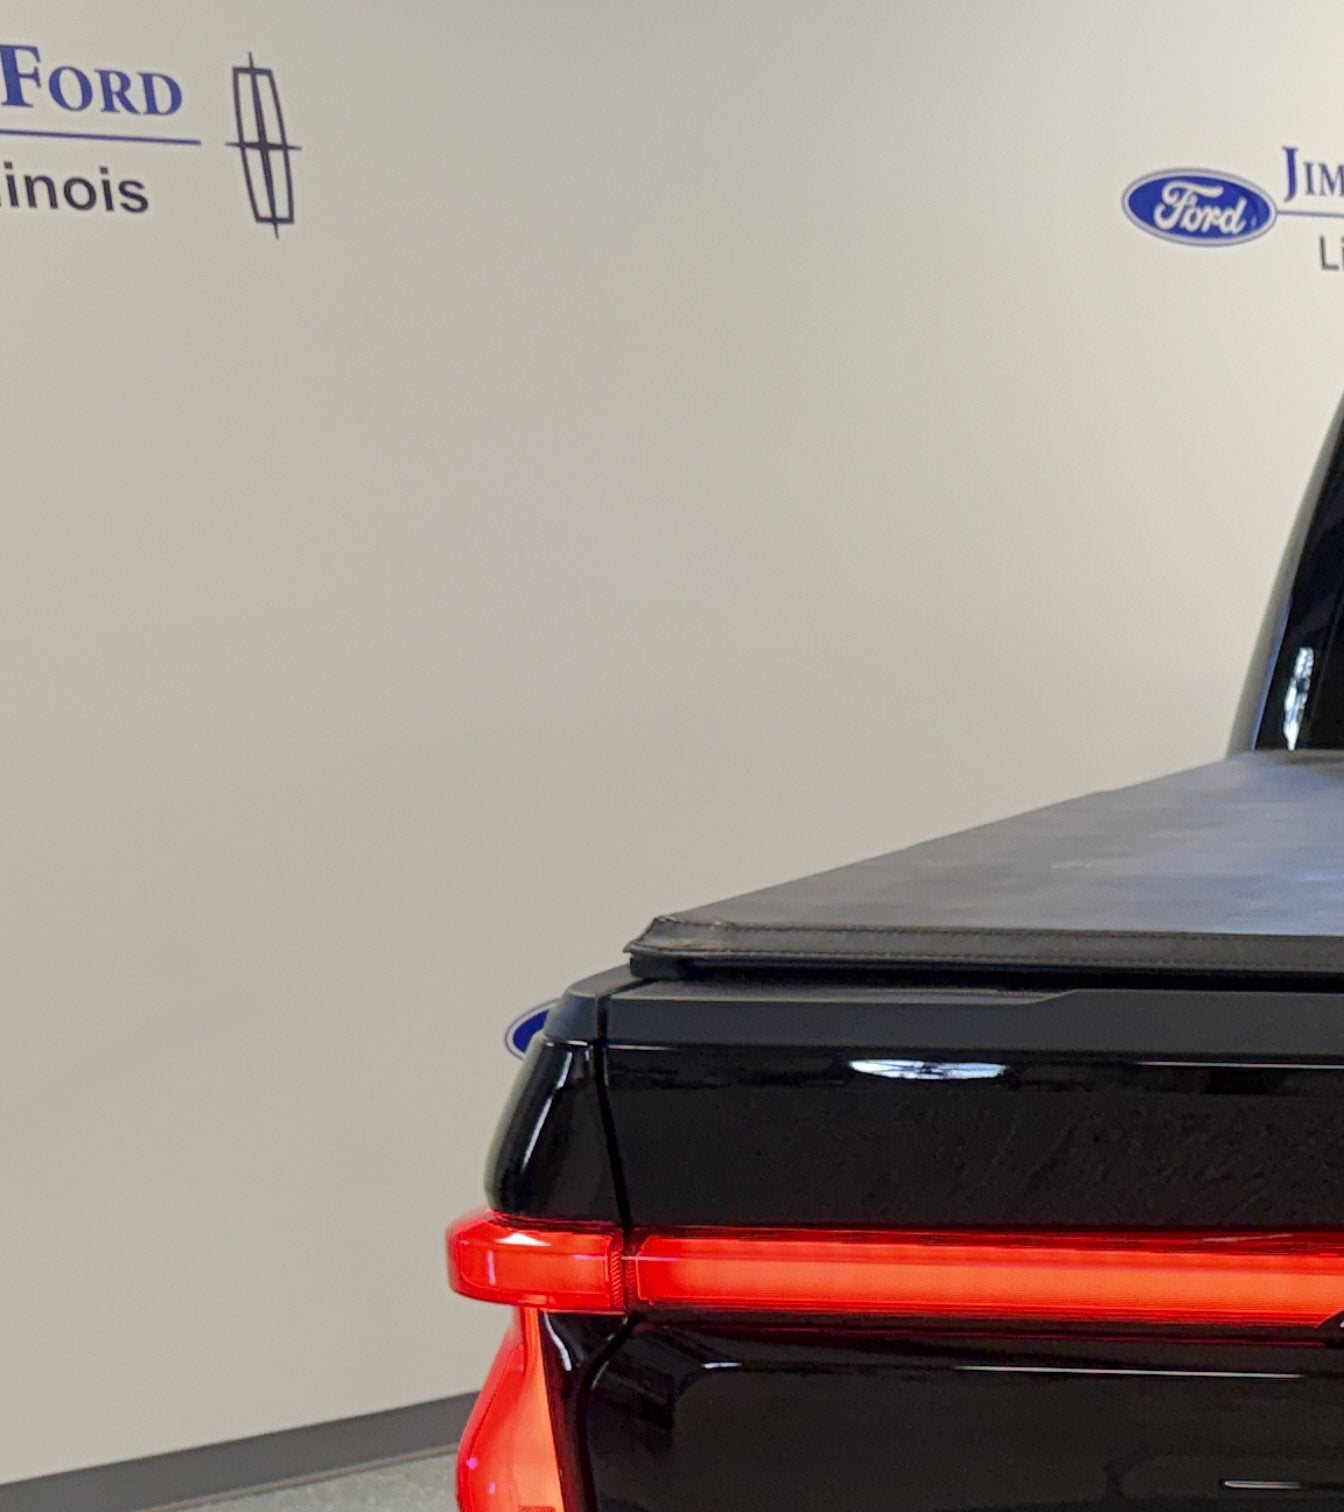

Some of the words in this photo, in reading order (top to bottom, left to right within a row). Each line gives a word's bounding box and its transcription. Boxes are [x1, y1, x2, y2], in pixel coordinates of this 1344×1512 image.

[0, 44, 183, 116] FORD
[0, 160, 150, 215] inois
[1152, 180, 1247, 235] Ford
